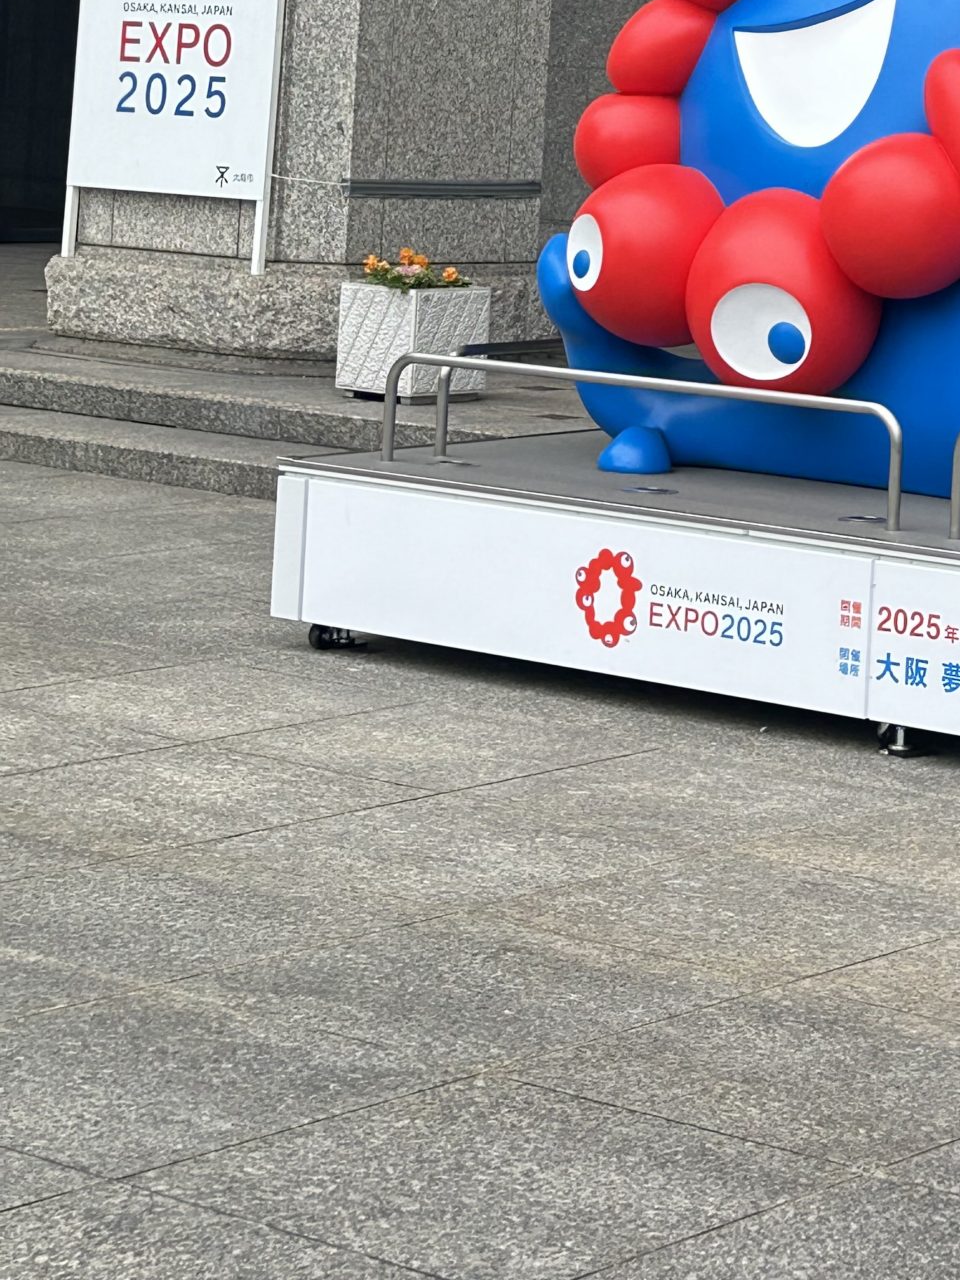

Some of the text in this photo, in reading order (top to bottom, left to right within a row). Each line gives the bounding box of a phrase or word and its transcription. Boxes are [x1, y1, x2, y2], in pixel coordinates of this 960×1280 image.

[123, 1, 233, 16] OSAKA, KANSAI, JAPAN
[119, 20, 232, 67] EXPO
[115, 71, 227, 118] 2025
[650, 584, 784, 616] OSAKA, KANSAI, JAPAN
[875, 652, 929, 689] 大阪
